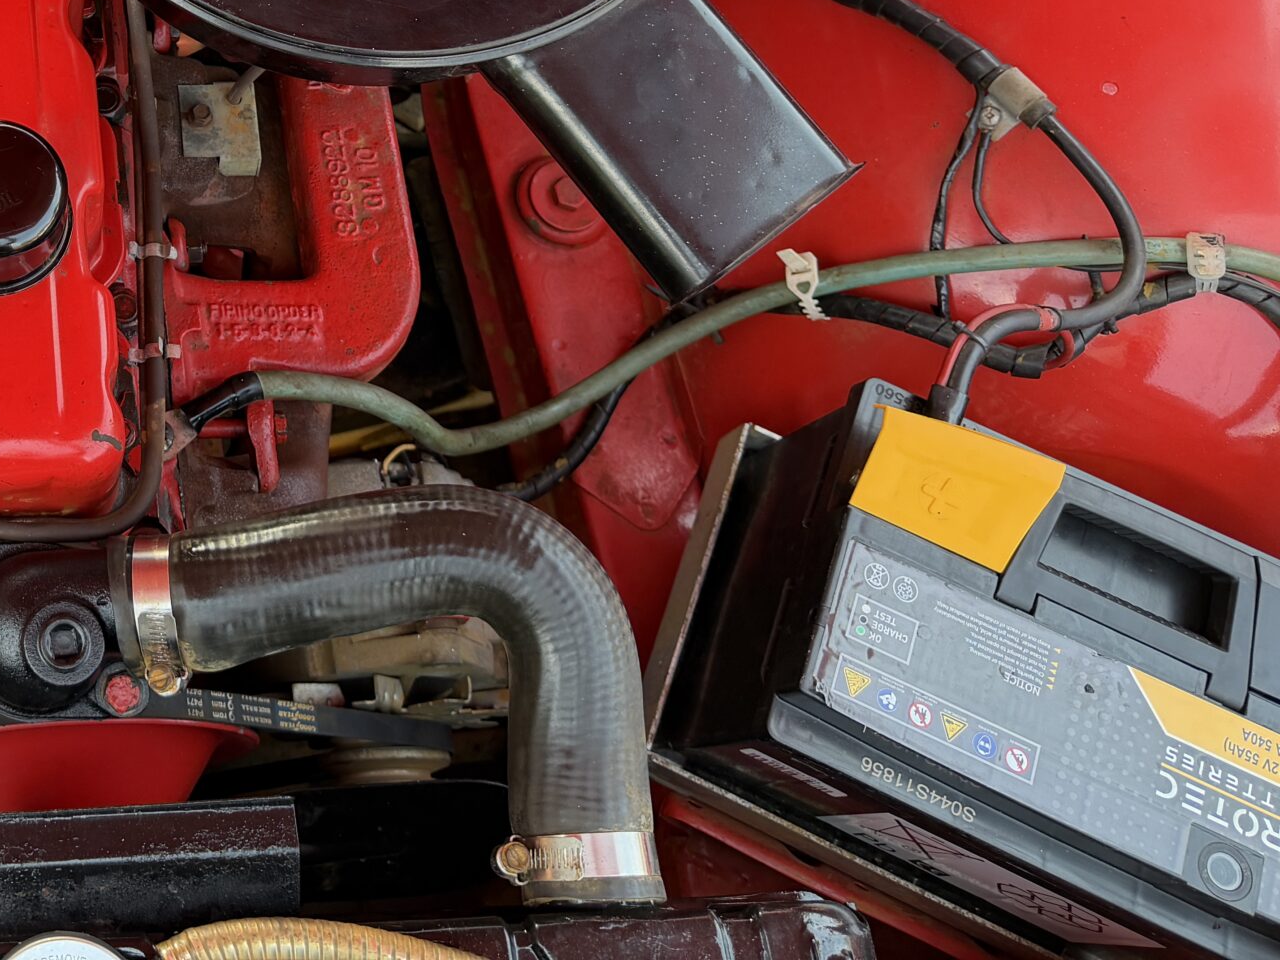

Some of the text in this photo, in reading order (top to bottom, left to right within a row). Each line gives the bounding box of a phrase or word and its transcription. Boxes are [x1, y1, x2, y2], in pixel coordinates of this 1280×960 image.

[873, 610, 897, 626] TEST
[868, 631, 882, 644] OK
[871, 620, 909, 643] CHARGE
[1003, 672, 1040, 696] NOTICE
[1224, 737, 1260, 766] 55Ah)
[1242, 728, 1272, 752] 540A
[860, 756, 976, 823] S044S11856
